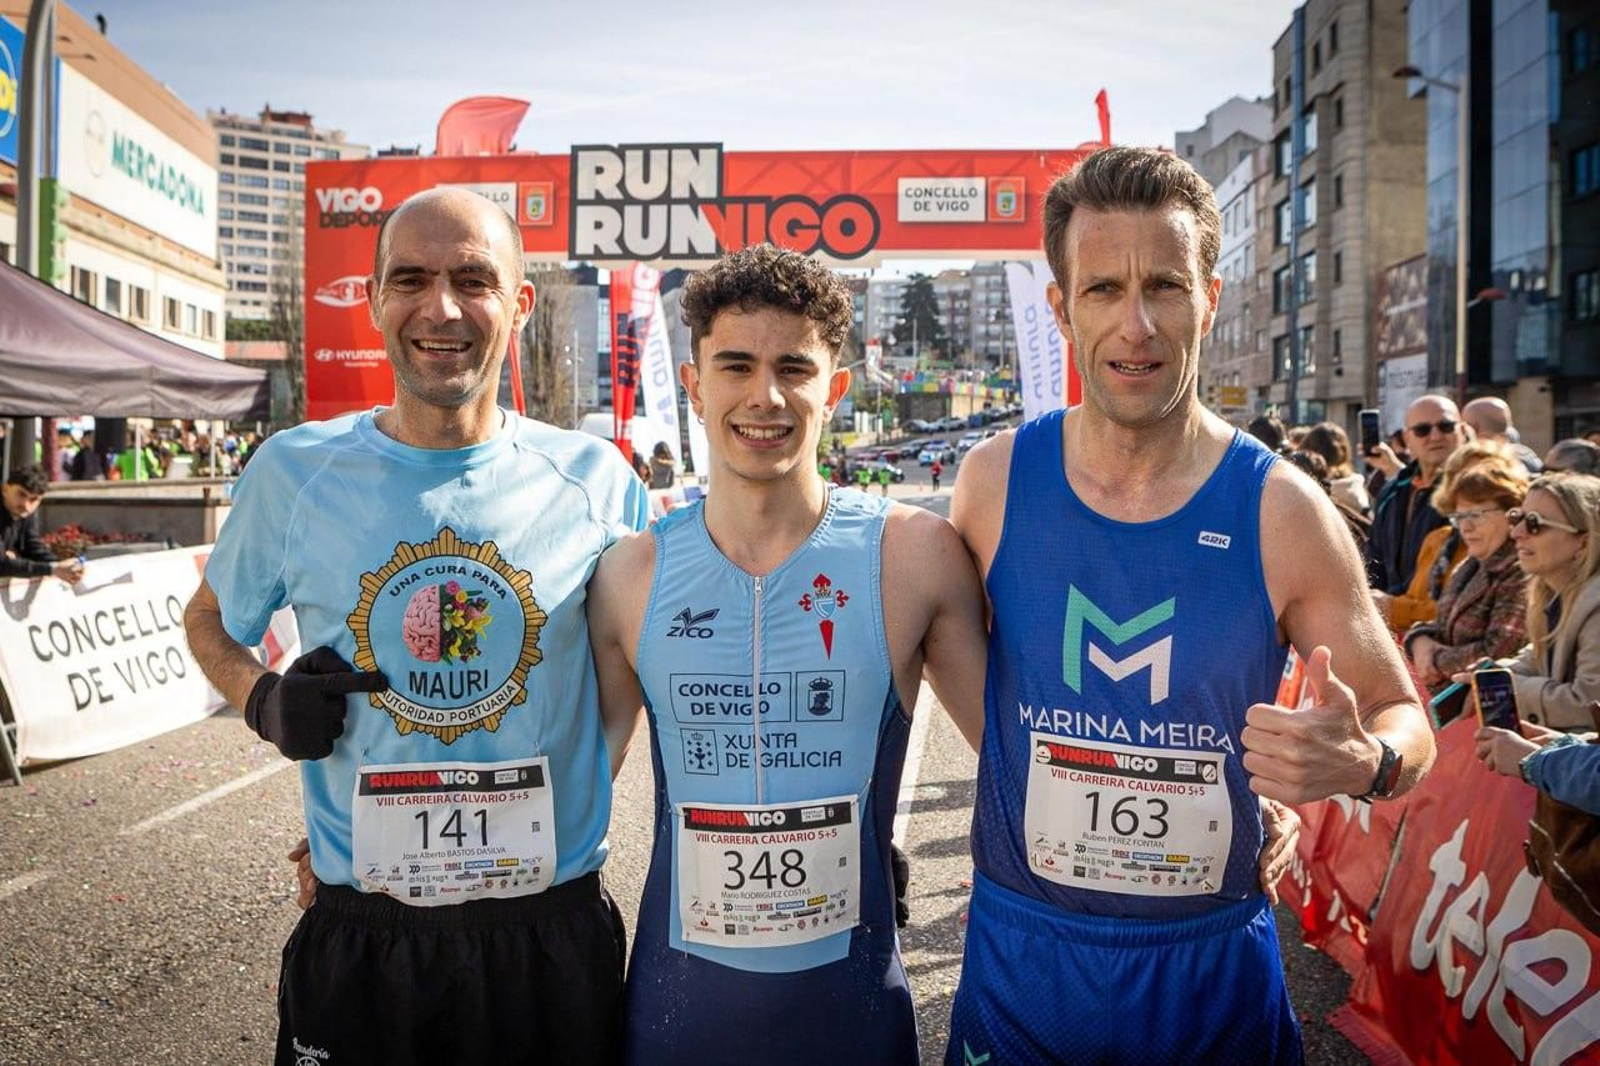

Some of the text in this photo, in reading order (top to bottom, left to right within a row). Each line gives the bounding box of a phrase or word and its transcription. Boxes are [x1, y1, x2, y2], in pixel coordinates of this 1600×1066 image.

[112, 130, 204, 216] MERCADONA
[577, 148, 718, 201] RUN
[315, 186, 383, 213] VIGO
[905, 187, 978, 199] CONCELLO
[914, 201, 970, 211] DE VIGO
[320, 211, 386, 228] DEPOR
[389, 565, 508, 600] UNA CURA PARA
[28, 594, 183, 663] CONCELLO
[666, 626, 714, 639] ZICO
[67, 645, 187, 711] DE VIGO
[409, 669, 489, 700] MAURI
[678, 682, 782, 698] CONCELLO
[379, 684, 516, 723] AUTORIDAD PORTUARIA
[691, 701, 770, 716] DE VIGO
[724, 732, 797, 749] XUNTA
[1019, 701, 1236, 755] MARINA MEIRA
[725, 751, 842, 768] DE GALICIA
[1051, 768, 1206, 797] VIII CARREIRA CALVARIO 5+5
[376, 791, 530, 806] VIII CARREIRA CALVARIO 5+5
[1085, 791, 1169, 839] 163
[414, 809, 489, 850] 141
[695, 829, 838, 845] VIII CARREIRA CALVARIO 5+5
[1108, 835, 1132, 846] PEREZ
[724, 849, 807, 890] 348
